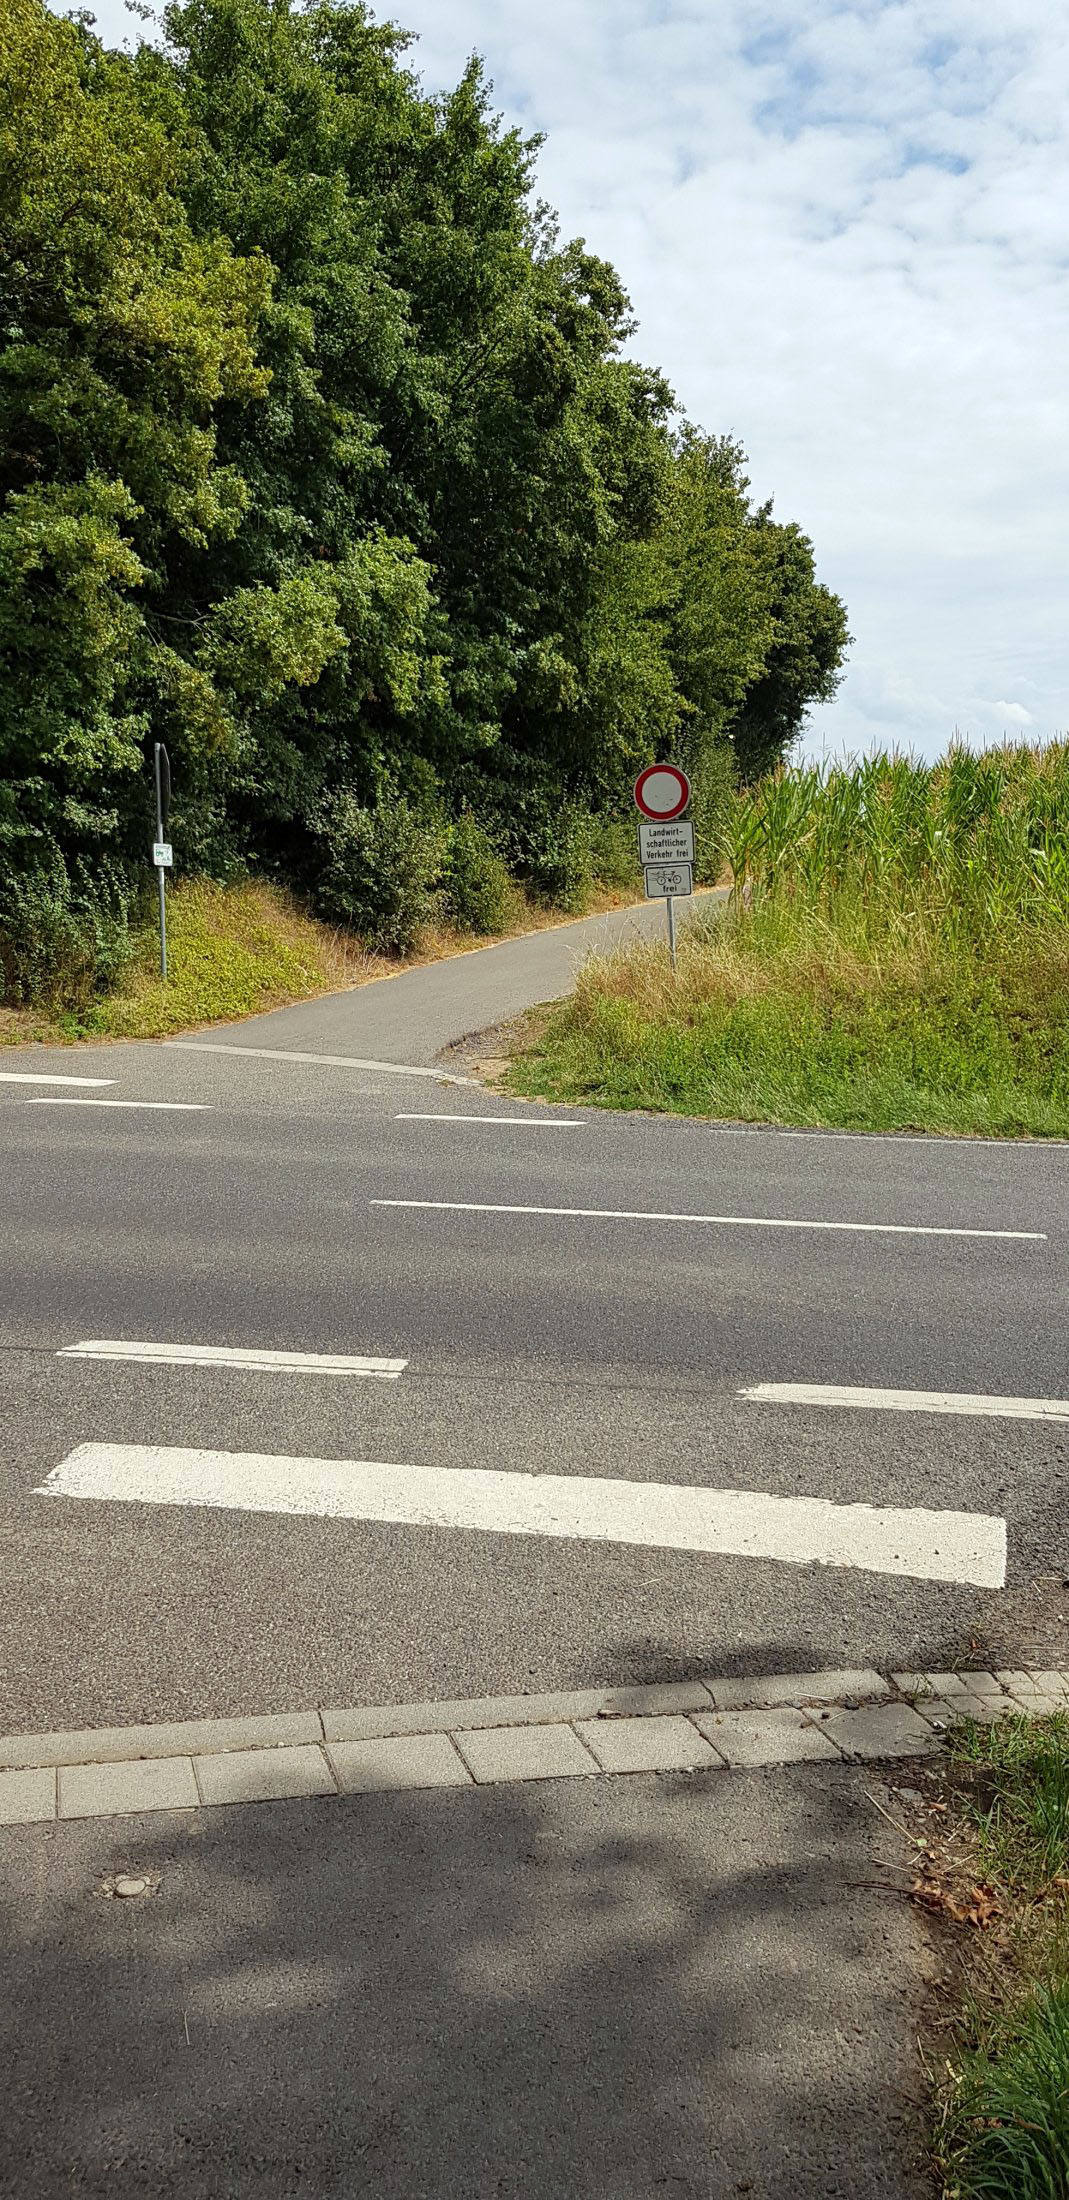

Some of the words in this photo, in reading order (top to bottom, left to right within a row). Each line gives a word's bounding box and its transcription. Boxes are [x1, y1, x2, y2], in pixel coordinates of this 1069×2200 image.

[649, 827, 684, 837] Landwirt-
[646, 839, 687, 848] schaftlicher
[646, 850, 673, 859] Verkehr
[676, 849, 689, 857] frei
[663, 885, 677, 893] frei
